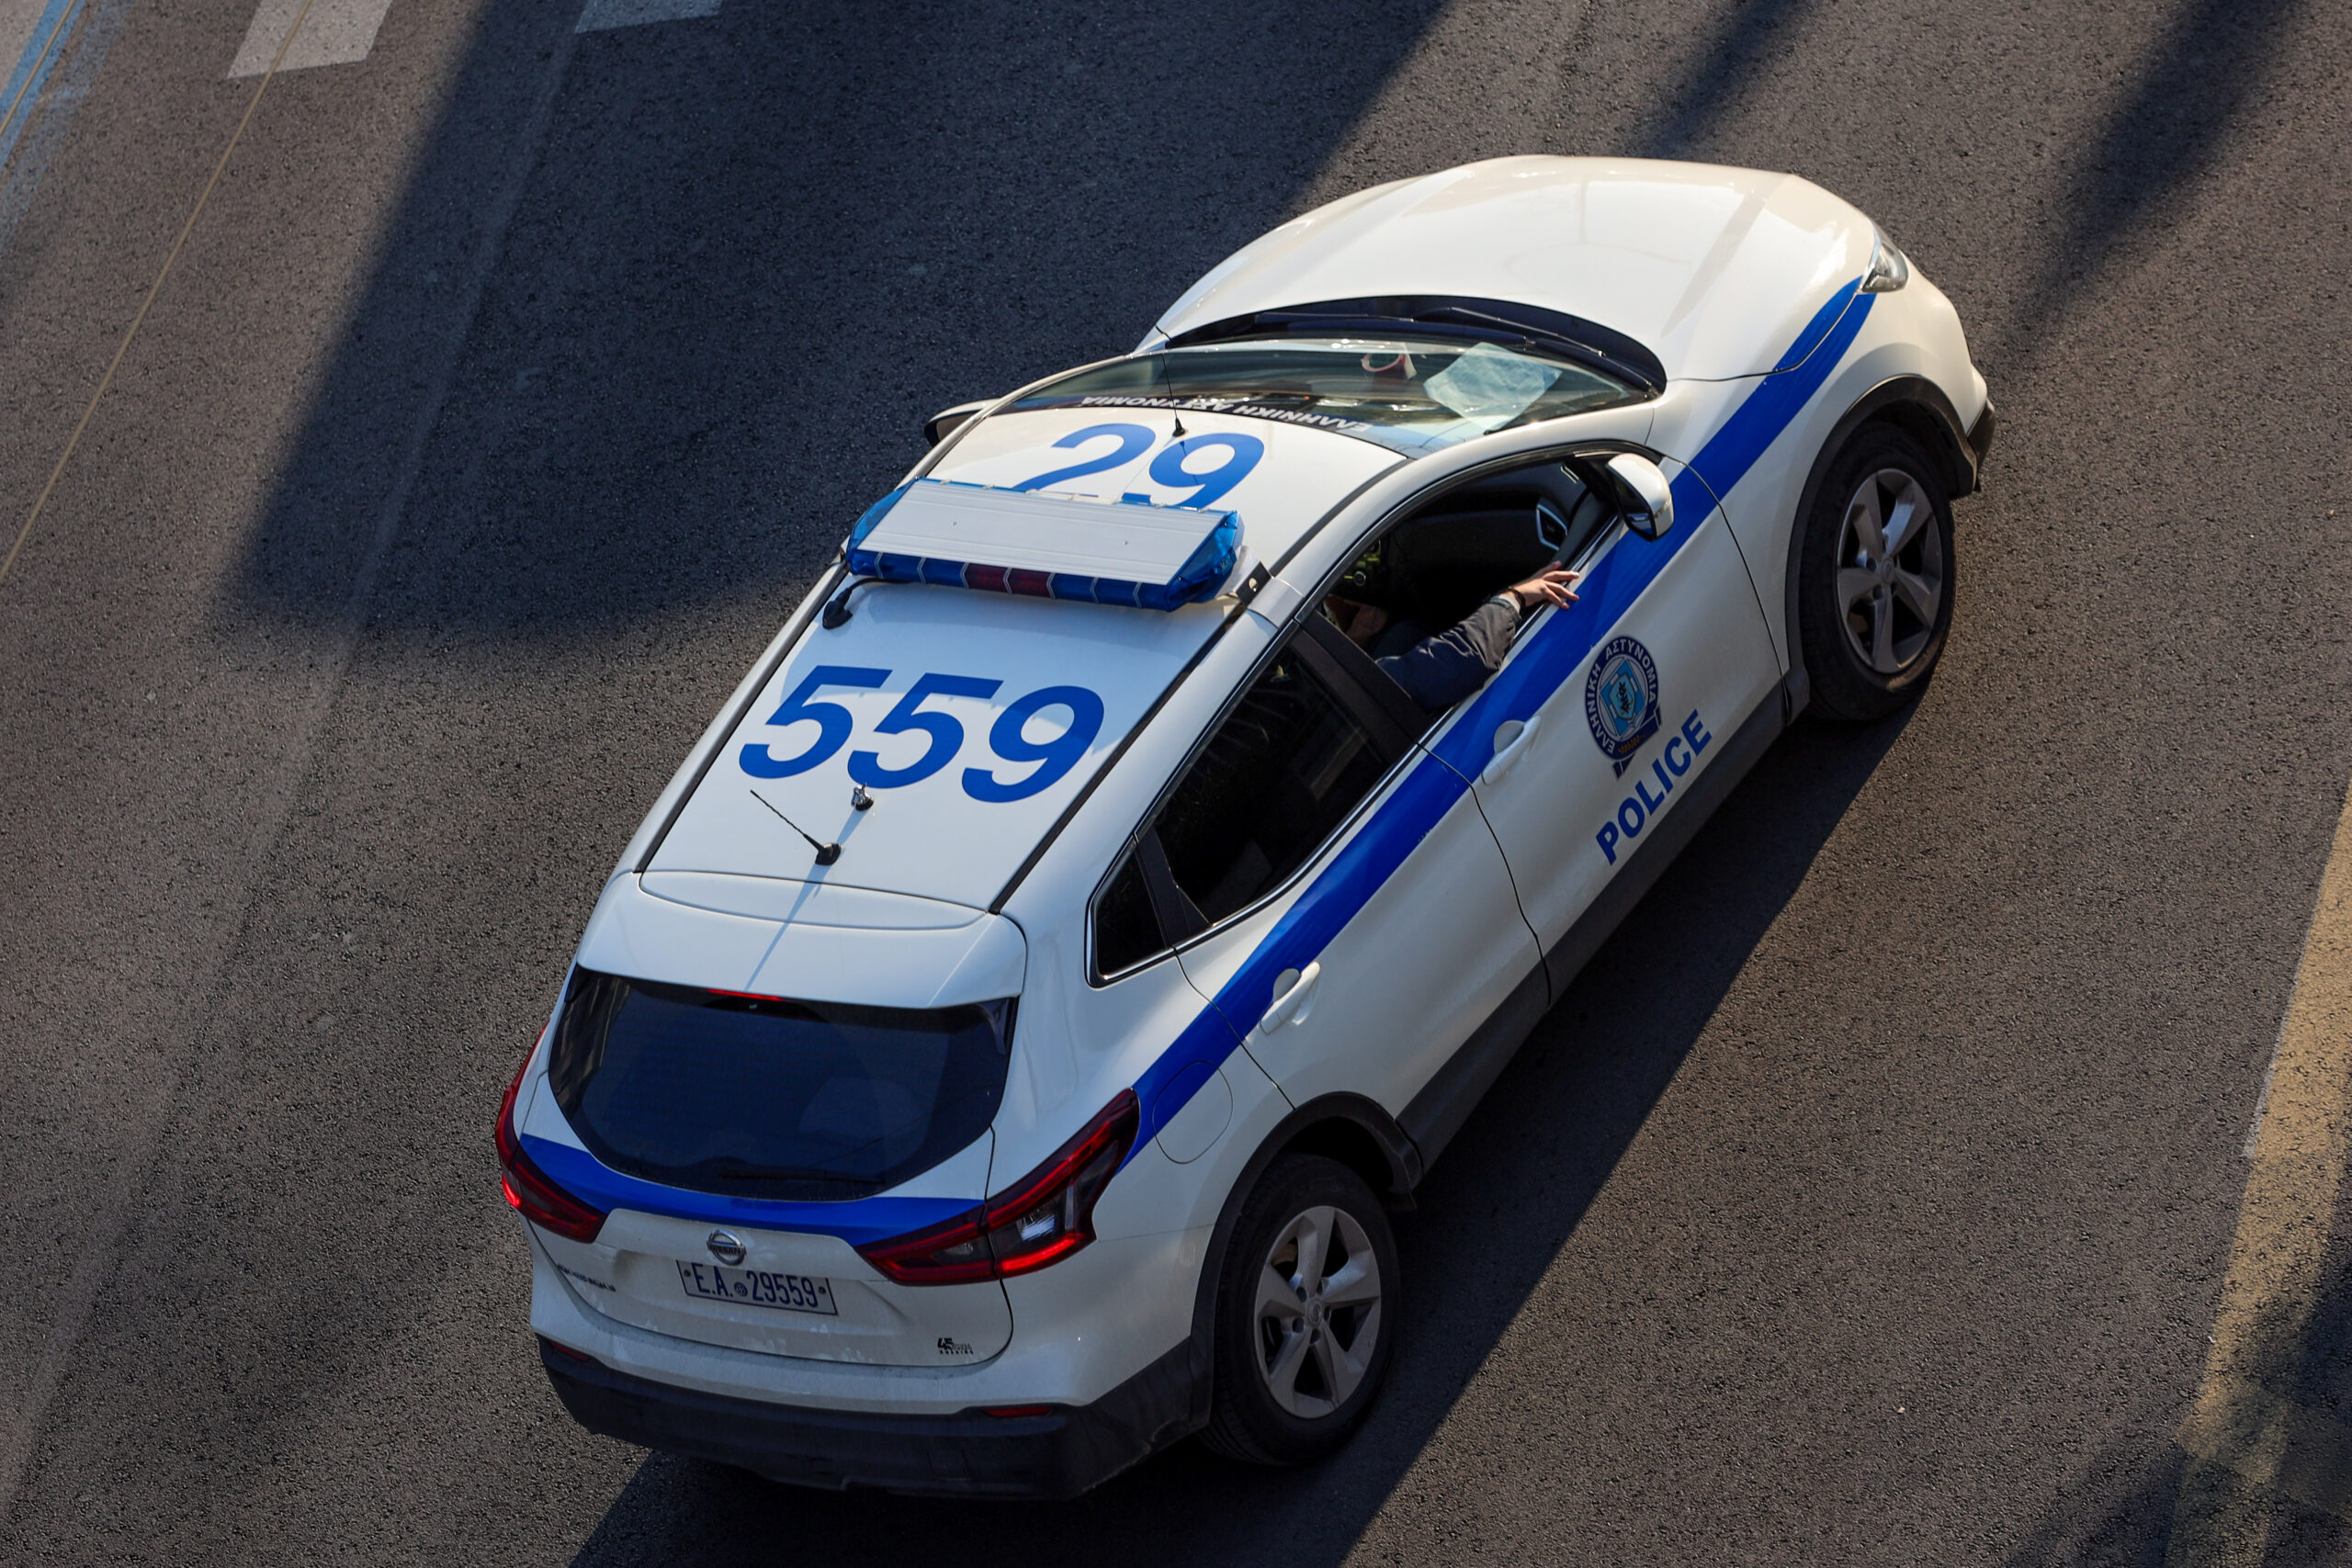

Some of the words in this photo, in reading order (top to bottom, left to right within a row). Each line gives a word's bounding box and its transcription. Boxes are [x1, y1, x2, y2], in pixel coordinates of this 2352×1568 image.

[1012, 423, 1265, 511] 29
[739, 664, 1105, 804] 559
[1587, 664, 1615, 754] ΕΛΛΗΝΙΚΗ
[1606, 638, 1657, 704] ΑΣΤΥΝΟΜΙΑ
[1596, 708, 1713, 865] POLICE
[746, 1270, 819, 1308] 29559
